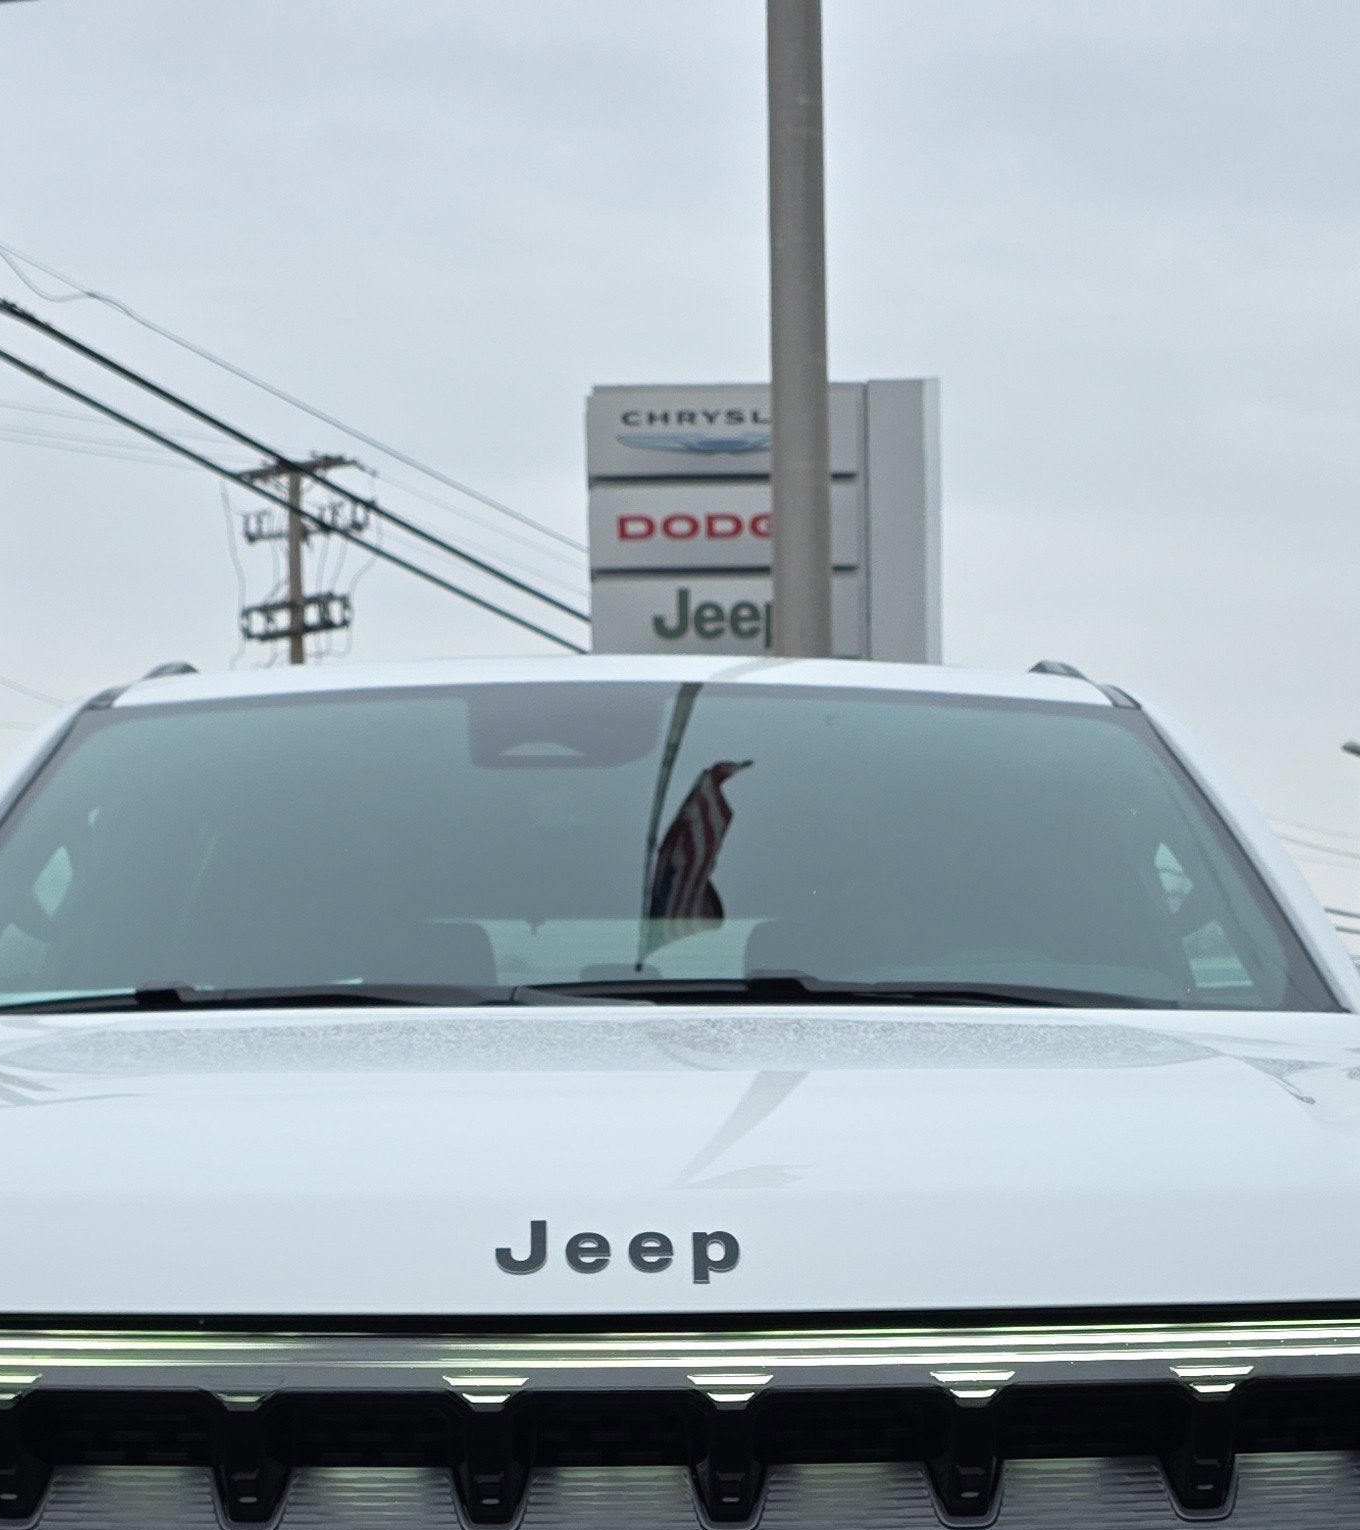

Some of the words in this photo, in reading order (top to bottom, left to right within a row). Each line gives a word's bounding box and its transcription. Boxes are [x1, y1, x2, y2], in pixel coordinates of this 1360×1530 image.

[620, 409, 772, 427] CHRYSL
[652, 587, 772, 650] Jee
[495, 1219, 740, 1285] Jeep
